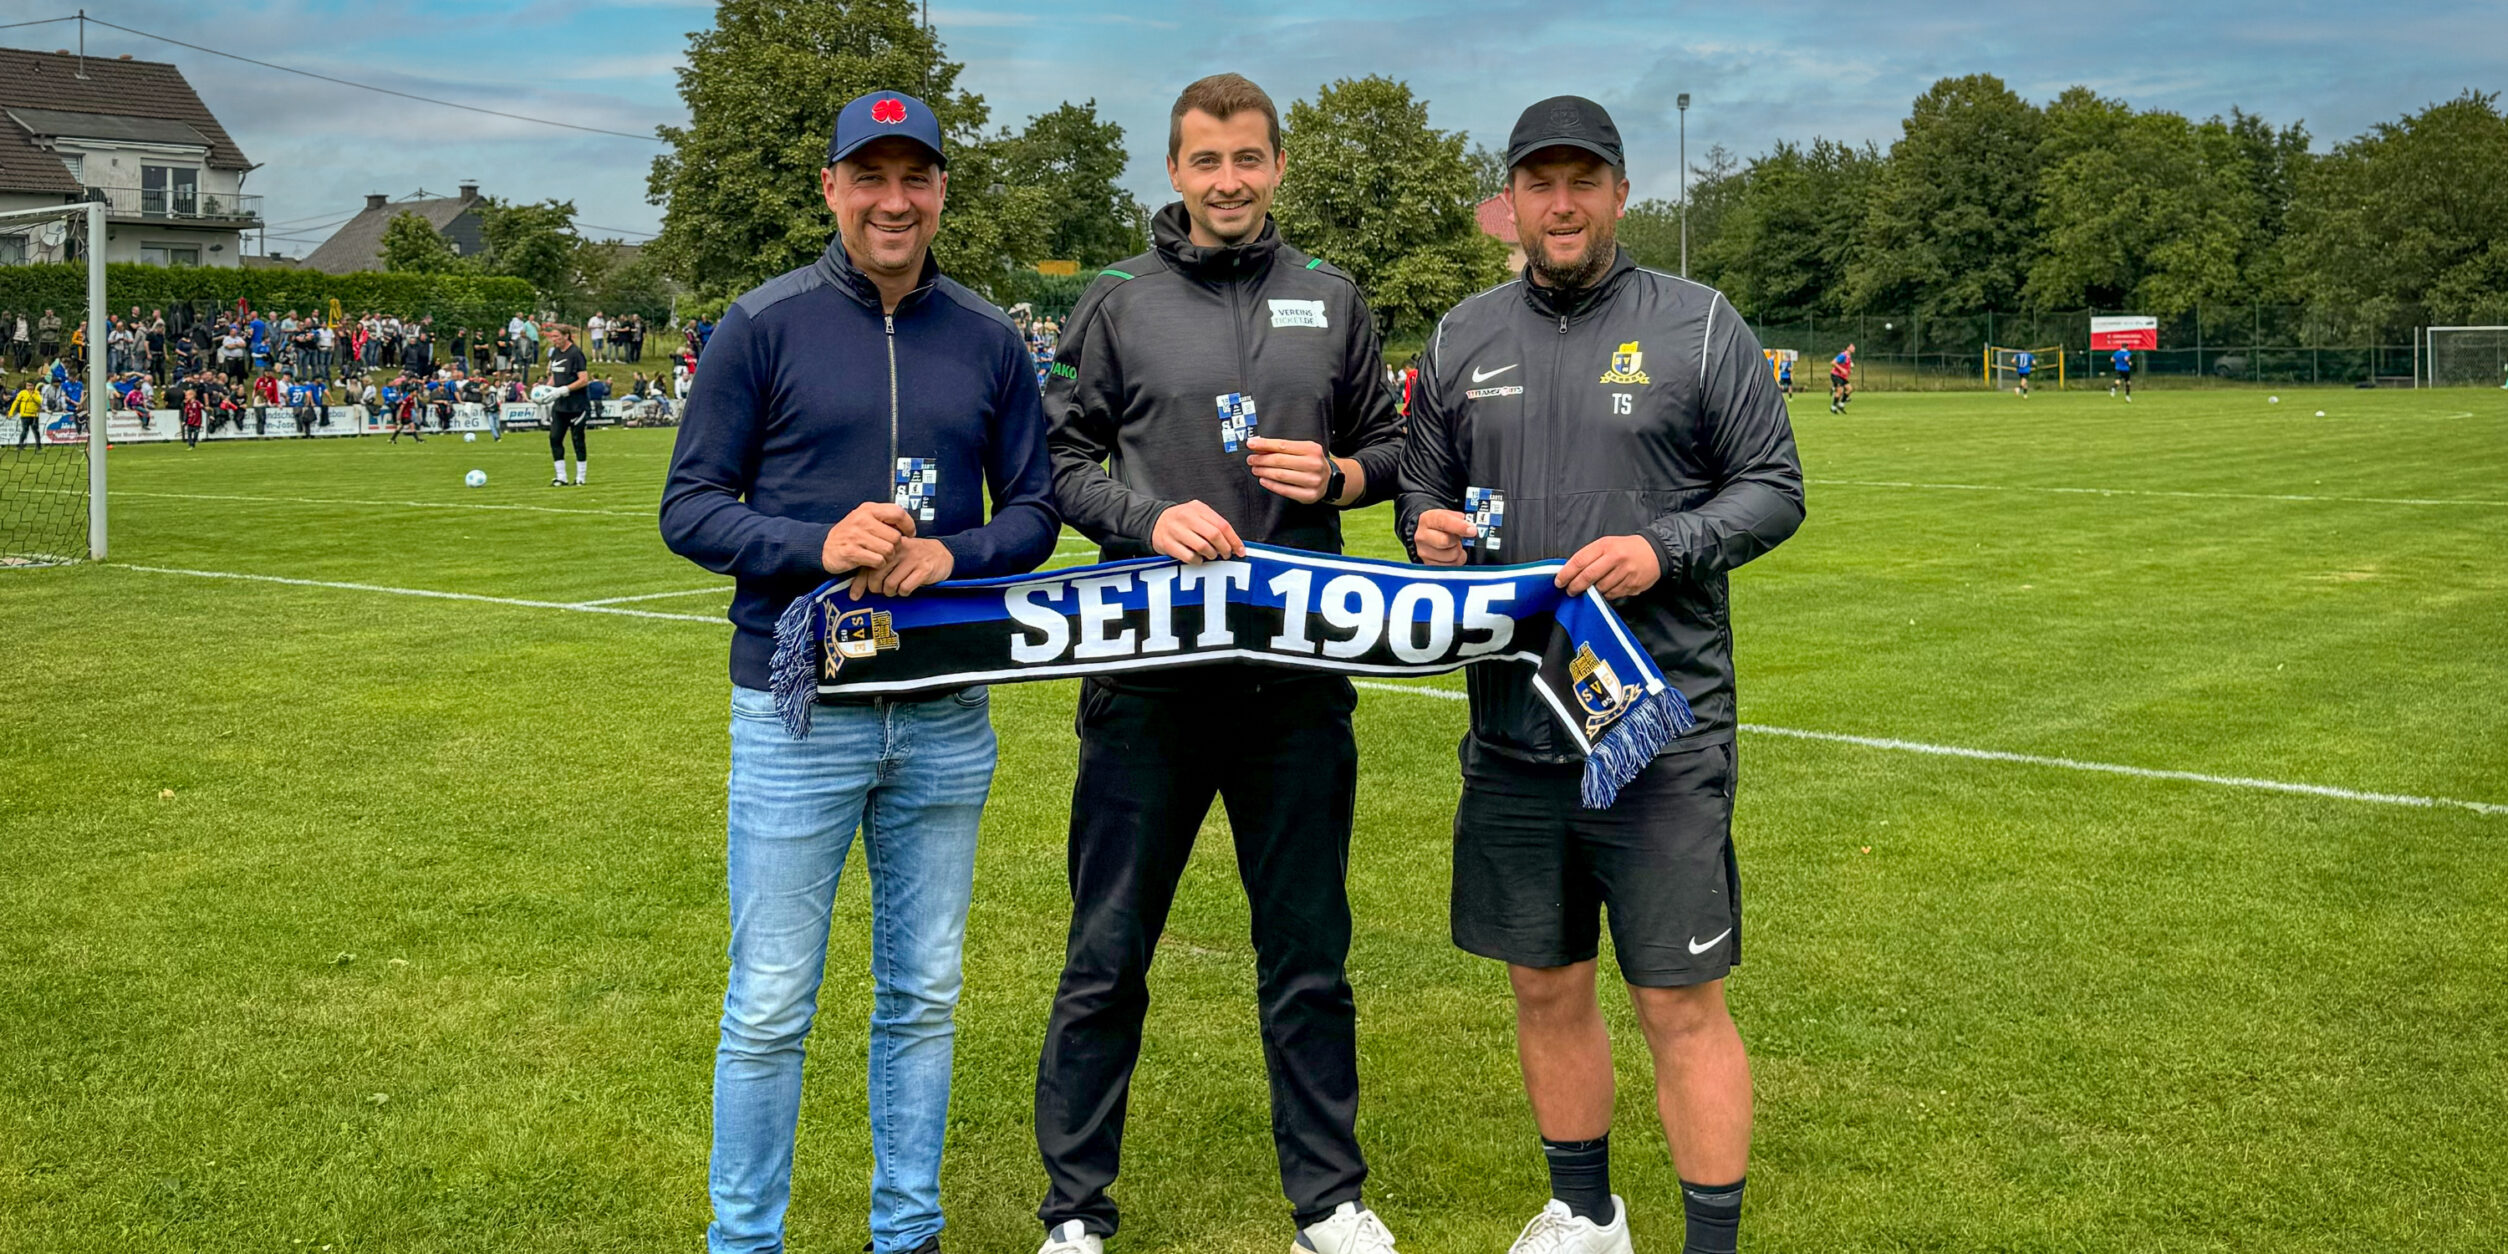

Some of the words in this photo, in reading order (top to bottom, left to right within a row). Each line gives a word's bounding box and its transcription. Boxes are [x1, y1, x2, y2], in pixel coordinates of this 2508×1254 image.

[1278, 309, 1313, 317] VEREINS
[292, 391, 304, 404] 27
[1611, 392, 1633, 415] TS
[1004, 561, 1252, 664] SEIT
[1267, 567, 1517, 663] 1905
[1600, 695, 1613, 708] 05
